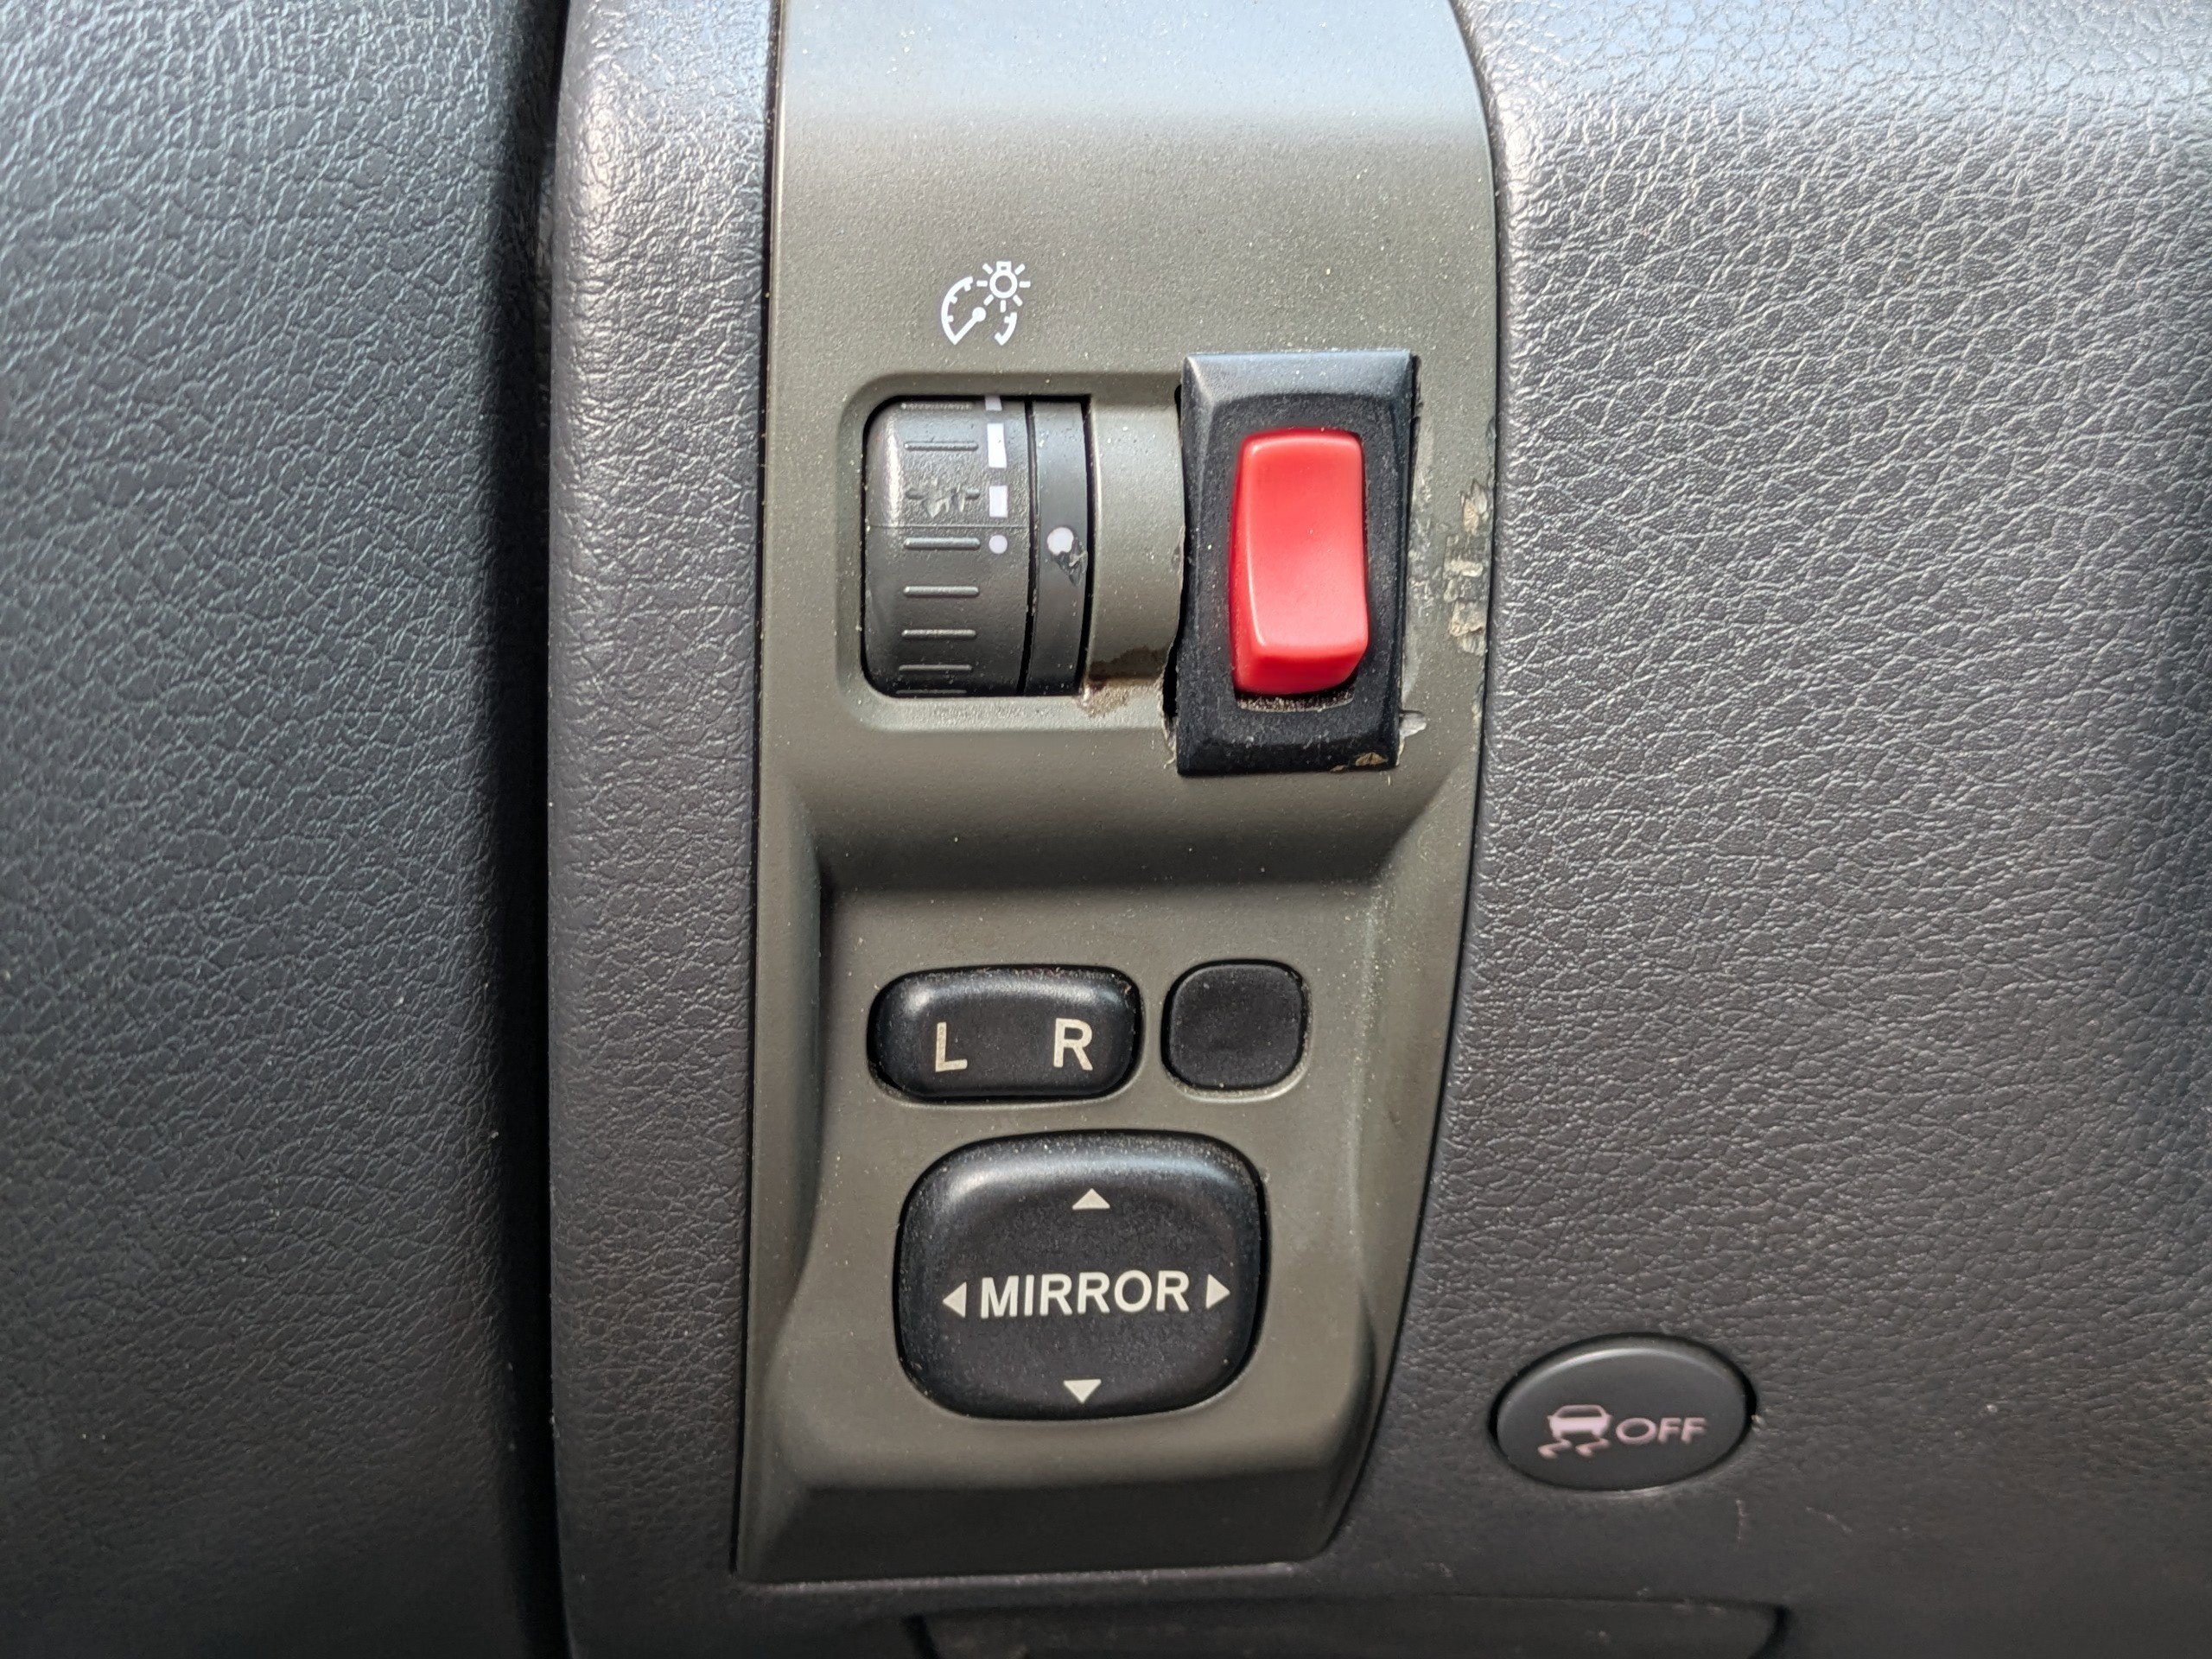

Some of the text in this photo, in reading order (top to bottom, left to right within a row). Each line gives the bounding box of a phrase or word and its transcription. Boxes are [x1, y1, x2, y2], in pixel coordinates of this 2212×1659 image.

[934, 1017, 1094, 1073] L R
[980, 1269, 1190, 1319] MIRROR
[1615, 1417, 1707, 1446] OFF
